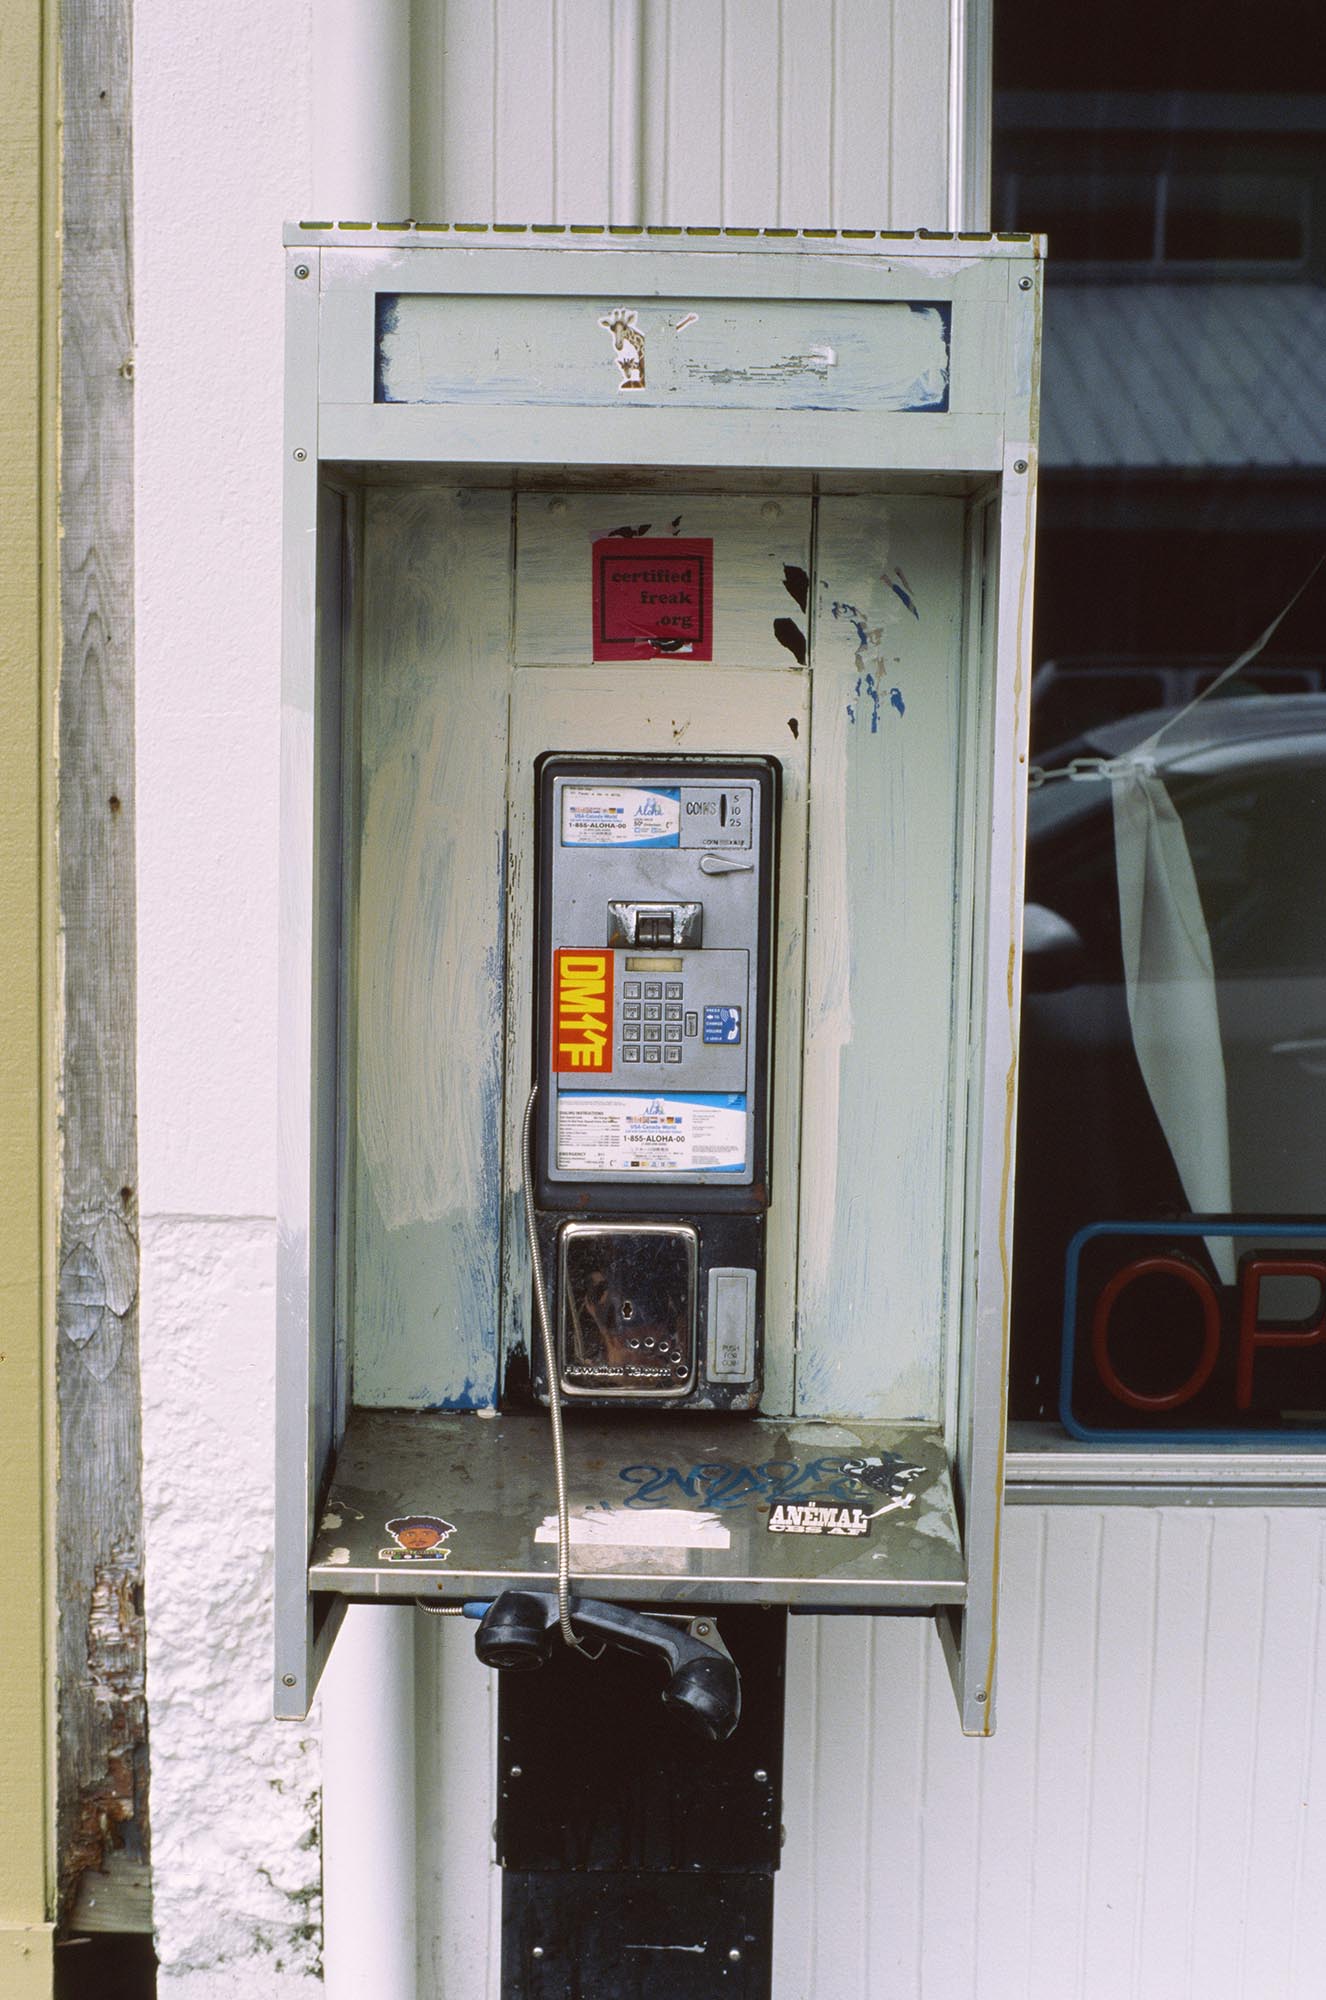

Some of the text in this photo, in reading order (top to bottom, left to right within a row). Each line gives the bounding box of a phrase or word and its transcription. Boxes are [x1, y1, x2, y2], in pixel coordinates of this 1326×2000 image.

[612, 568, 692, 583] certified
[640, 590, 692, 605] freak
[656, 614, 693, 629] .org
[734, 795, 740, 803] 5
[731, 806, 741, 816] 10
[730, 819, 742, 827] 25
[564, 1365, 624, 1376] Hawaiian
[769, 1501, 868, 1528] ANËMAL
